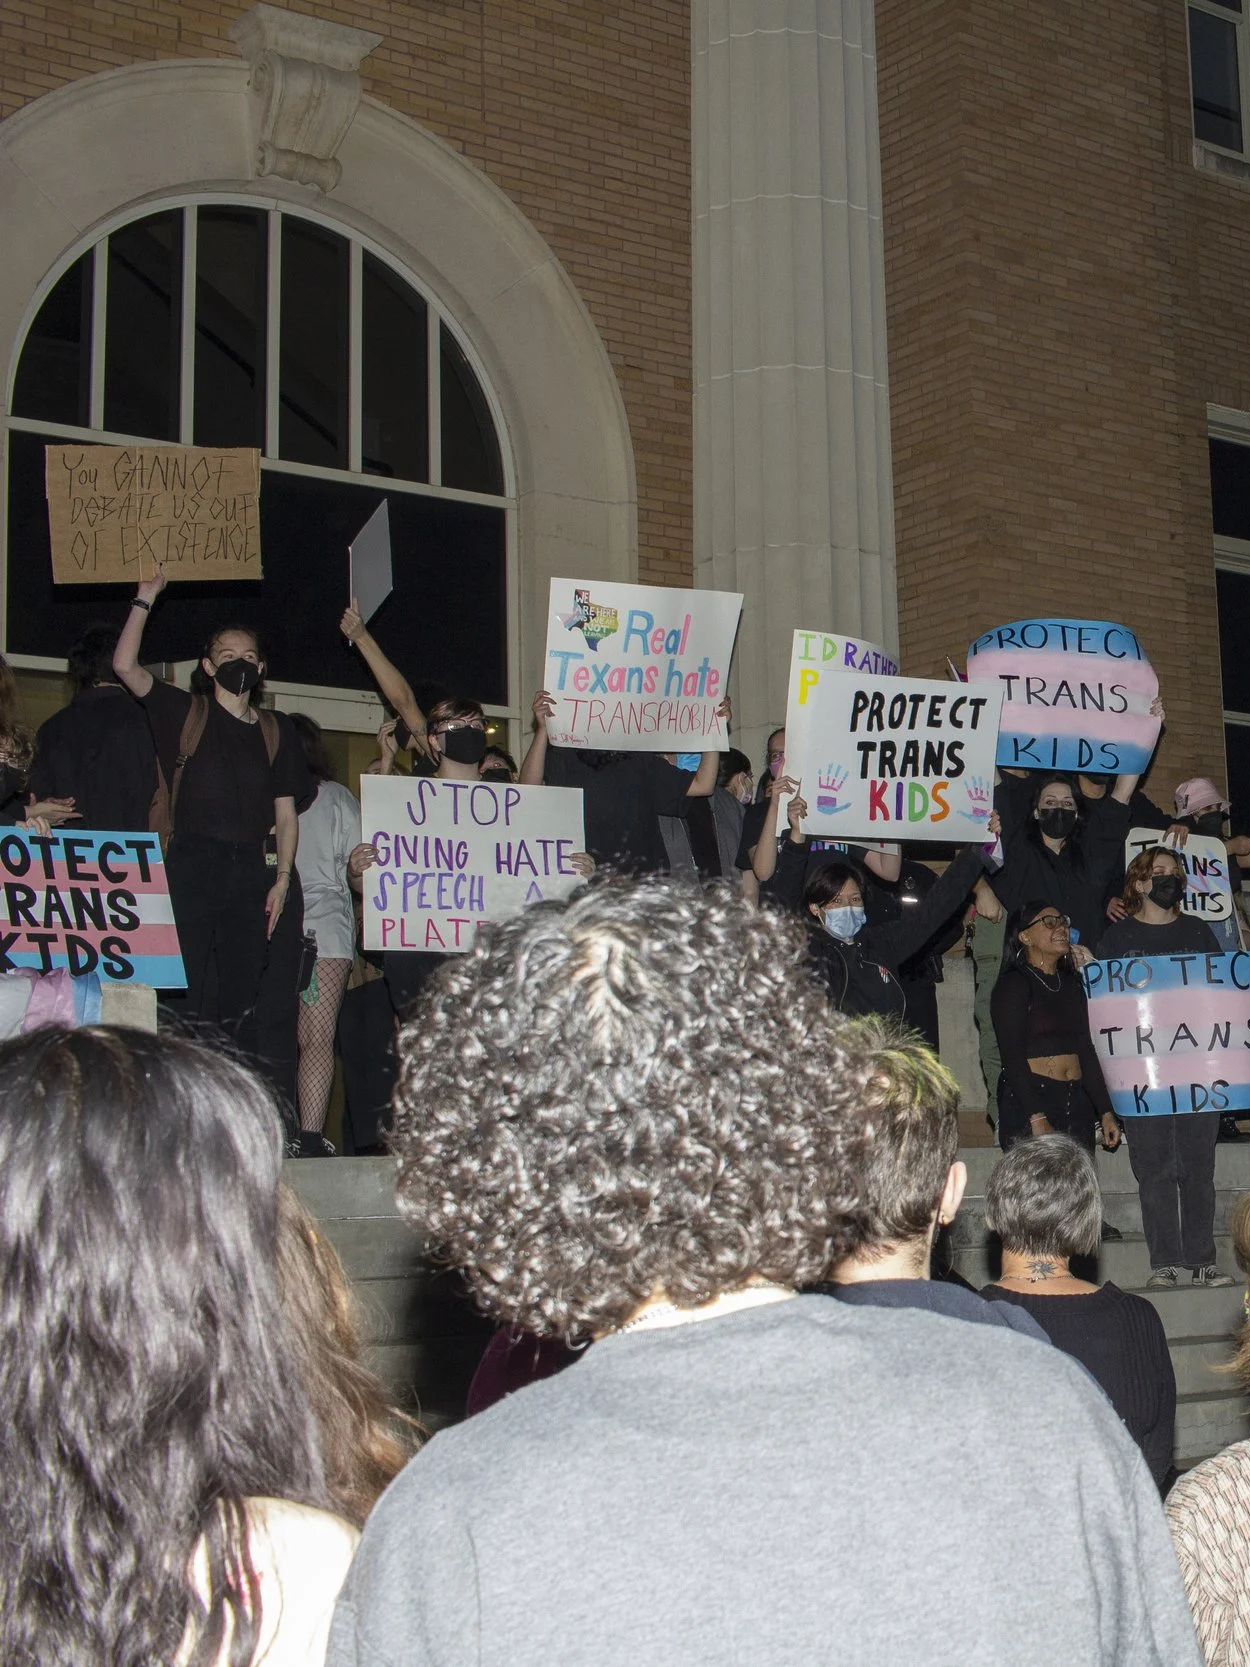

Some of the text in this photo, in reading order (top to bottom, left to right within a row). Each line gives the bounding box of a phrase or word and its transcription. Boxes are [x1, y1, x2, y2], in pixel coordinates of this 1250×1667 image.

[71, 491, 258, 527] DEBATE US OUT
[71, 520, 257, 571] OF EXISTENCE
[623, 609, 692, 656] Real
[798, 633, 838, 662] I'D
[973, 623, 1143, 661] PROTECT
[549, 650, 720, 698] Texans hate
[998, 674, 1129, 714] TRANS
[564, 698, 721, 737] TRANSPHOBIA
[850, 690, 988, 733] PROTECT
[857, 739, 966, 779] TRANS
[1013, 737, 1121, 770] KIDS
[407, 779, 521, 826] STOP
[869, 779, 951, 823] KIDS
[372, 831, 577, 877] GIVING HATE
[0, 882, 140, 931] RANS
[373, 872, 485, 913] SPEECH
[381, 917, 492, 948] PLAT
[1133, 1079, 1230, 1114] KIDS
